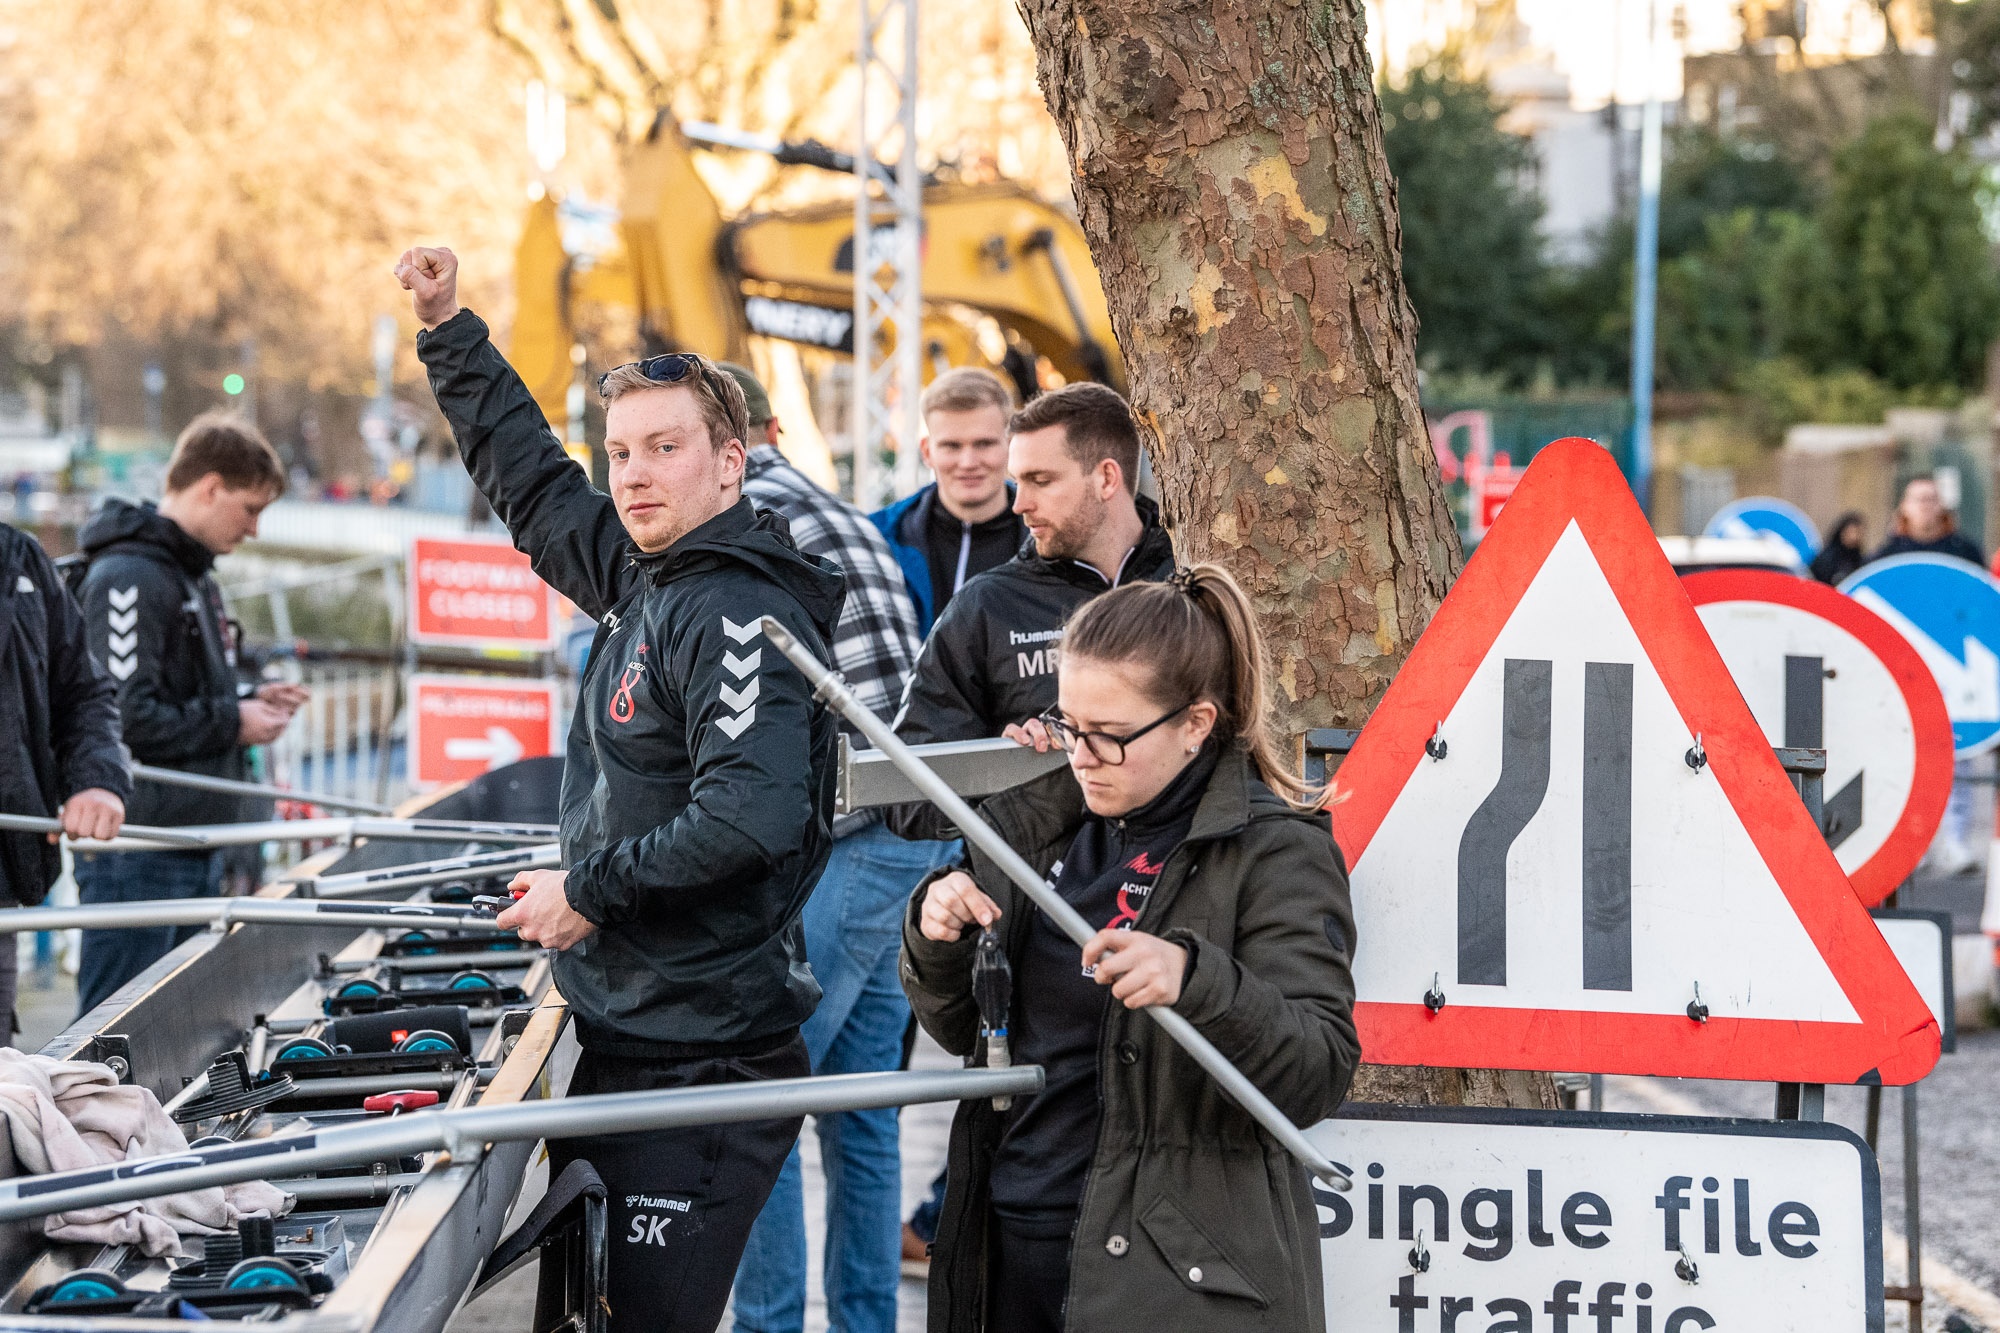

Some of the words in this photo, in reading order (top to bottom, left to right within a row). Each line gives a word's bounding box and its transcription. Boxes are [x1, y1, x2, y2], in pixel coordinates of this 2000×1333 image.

[429, 589, 537, 622] CLOSED
[1018, 649, 1060, 678] MR
[1120, 882, 1152, 896] ACHT
[638, 1194, 692, 1213] hummel
[1311, 1160, 1612, 1262] Single
[1655, 1176, 1821, 1259] file
[627, 1214, 672, 1247] SK
